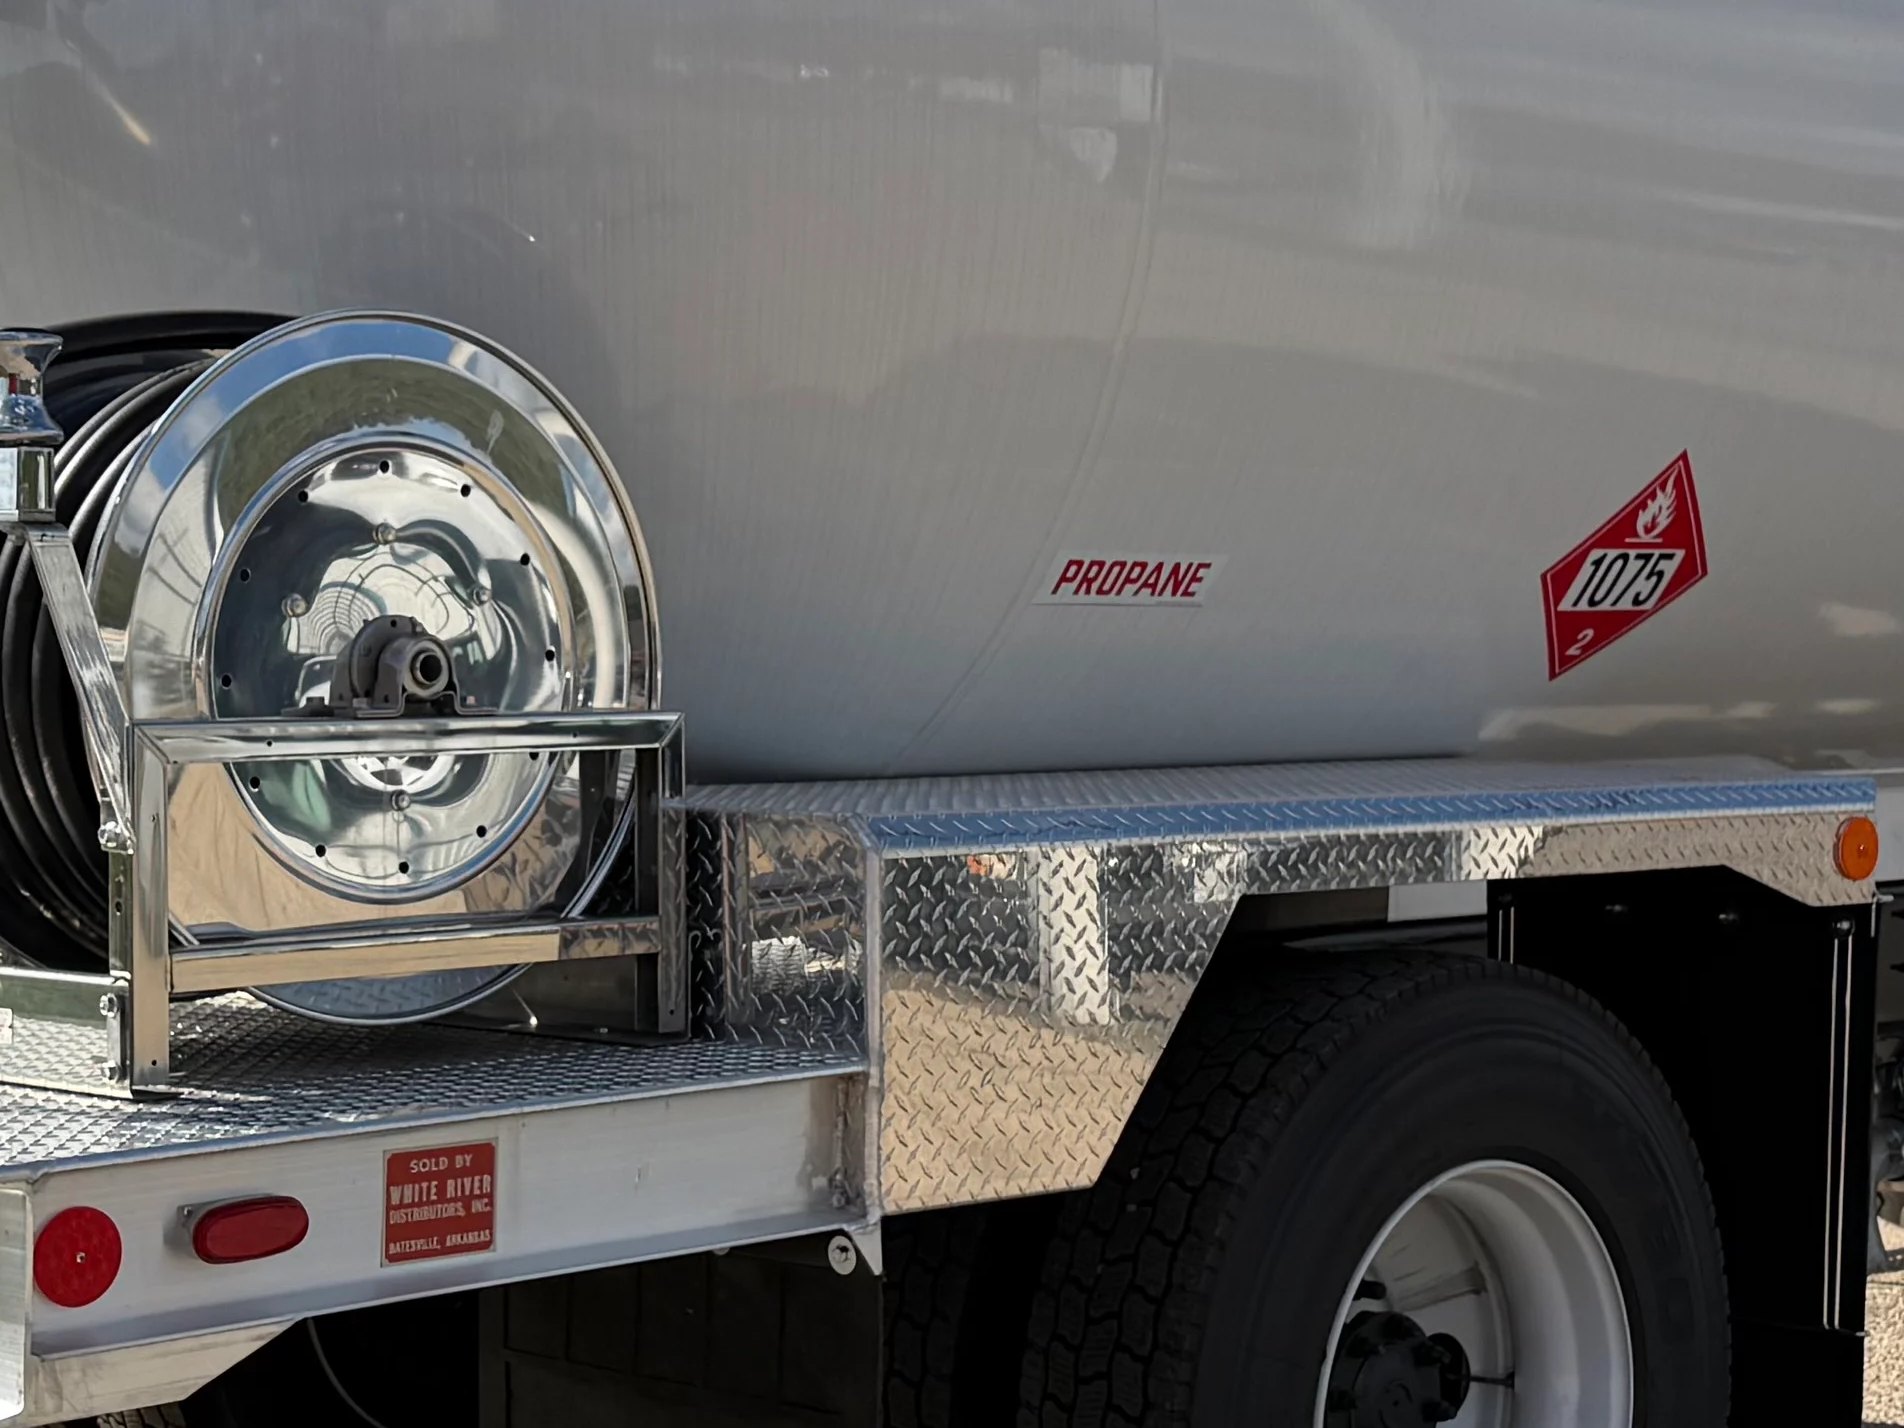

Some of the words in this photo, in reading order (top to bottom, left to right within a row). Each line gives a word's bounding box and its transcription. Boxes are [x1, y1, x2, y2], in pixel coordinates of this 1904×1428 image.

[1050, 559, 1213, 598] PROPANE
[1571, 552, 1676, 608] 1075
[1564, 628, 1595, 656] 2
[409, 1156, 449, 1173] SOLD
[455, 1153, 473, 1168] BY
[389, 1181, 438, 1205] WHITE
[447, 1174, 492, 1199] RIVER
